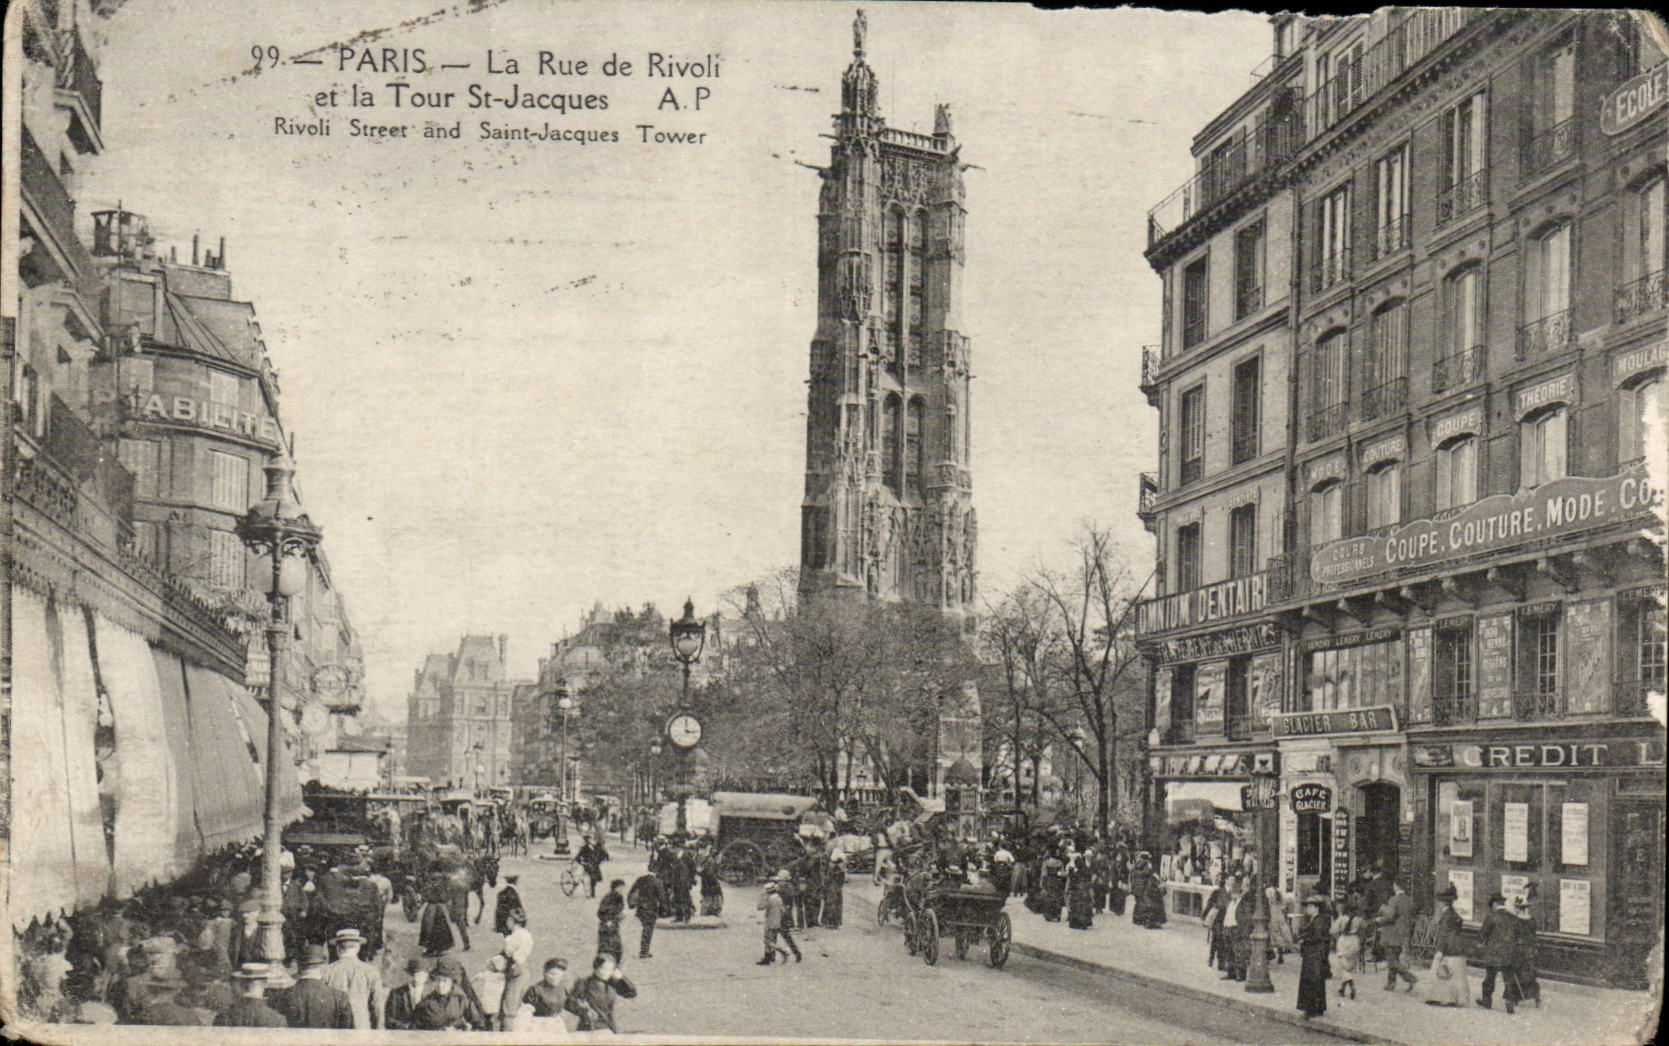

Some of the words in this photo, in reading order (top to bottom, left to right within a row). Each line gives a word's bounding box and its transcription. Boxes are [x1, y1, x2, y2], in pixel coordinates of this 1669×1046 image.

[1615, 72, 1664, 126] ECOLE
[1519, 379, 1567, 408] THEORIE
[1436, 411, 1476, 437] COUPE
[1363, 438, 1402, 462] COUTURE
[1311, 460, 1341, 478] MODE
[1332, 543, 1366, 561] COURS
[1139, 592, 1192, 634] OMNIUM
[1283, 715, 1332, 734] GLACIER
[1349, 711, 1378, 730] BAR
[1463, 744, 1609, 768] CREDIT
[1295, 800, 1327, 811] GLACIER
